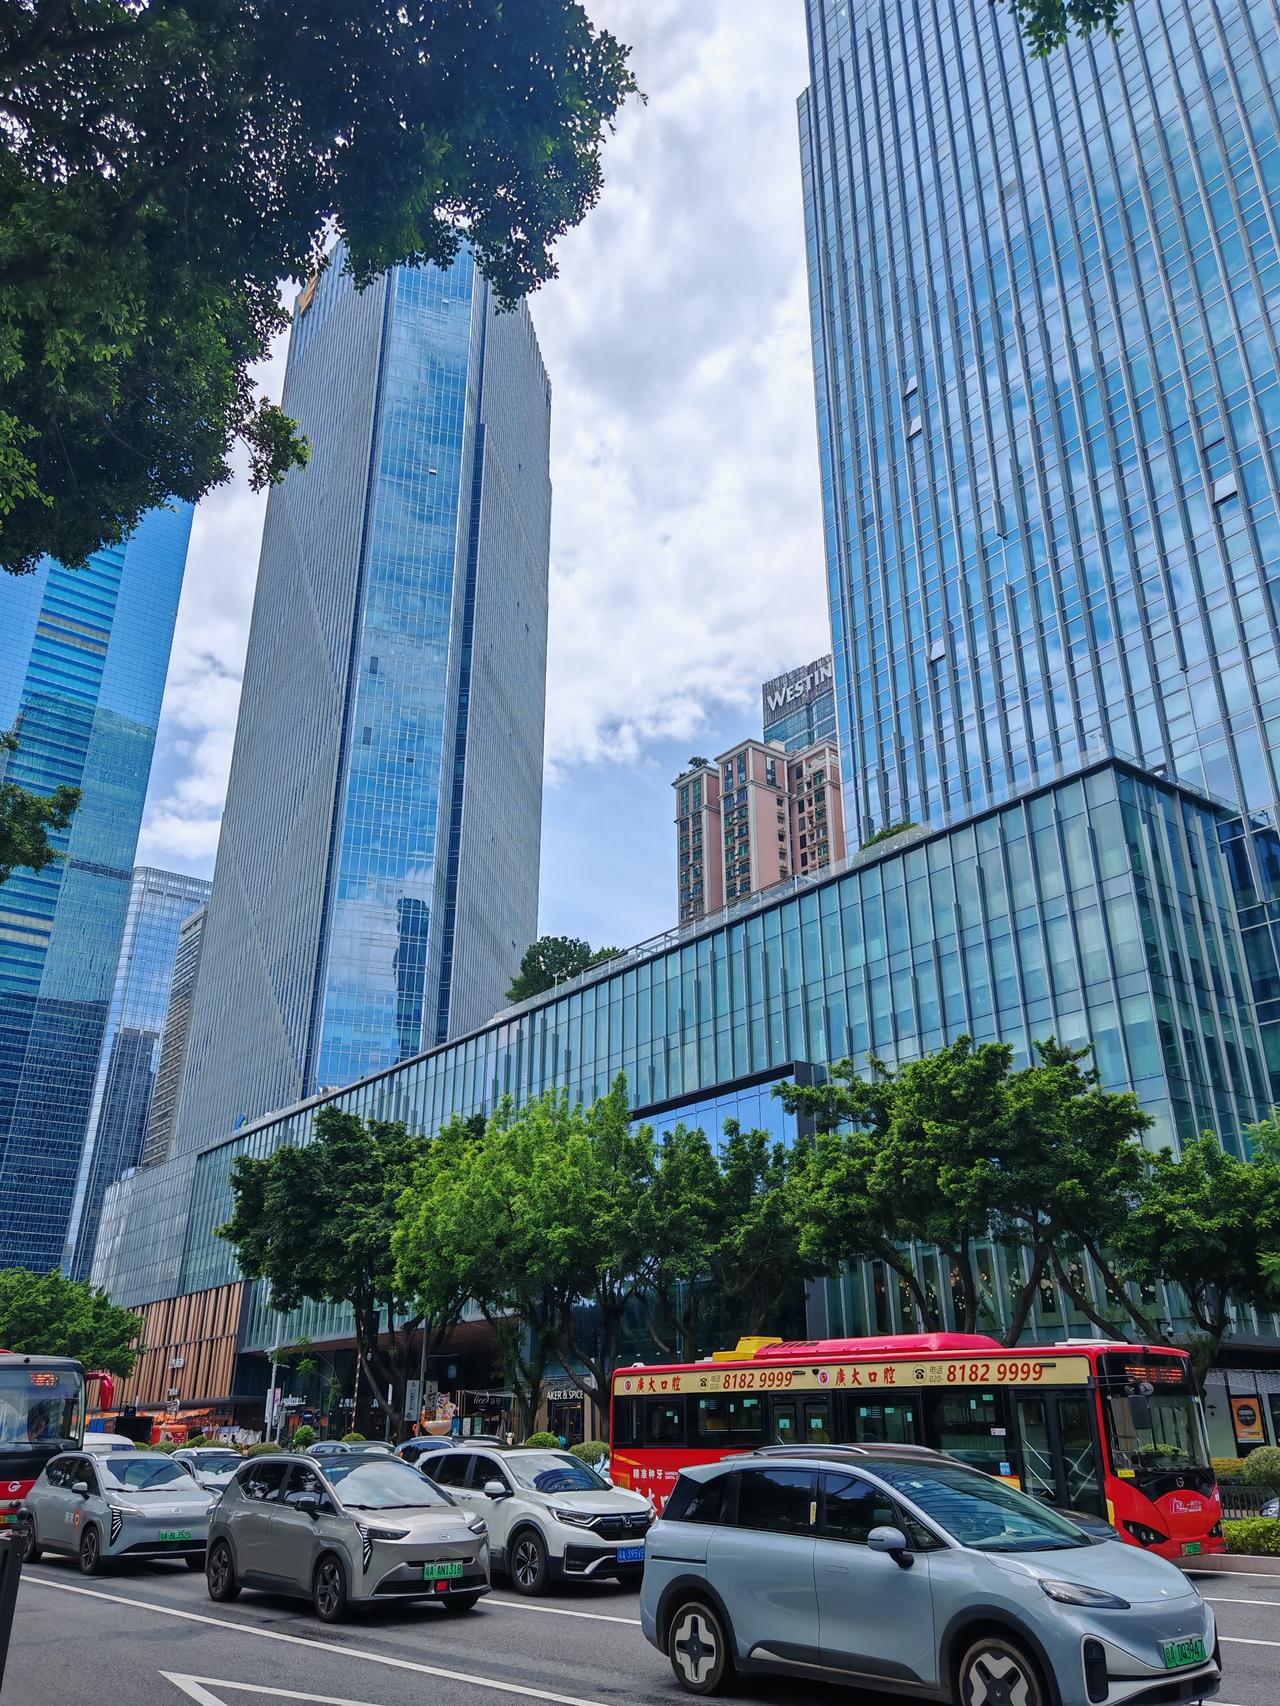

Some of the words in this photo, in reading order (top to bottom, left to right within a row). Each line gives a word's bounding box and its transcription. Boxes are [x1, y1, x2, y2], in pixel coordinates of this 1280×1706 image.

[766, 661, 832, 711] WESTIN
[723, 1372, 755, 1389] 8182
[759, 1371, 793, 1388] 9999
[947, 1363, 990, 1382] 8182
[997, 1362, 1043, 1381] 9999
[547, 1390, 562, 1400] AKER
[568, 1390, 584, 1399] SPICE
